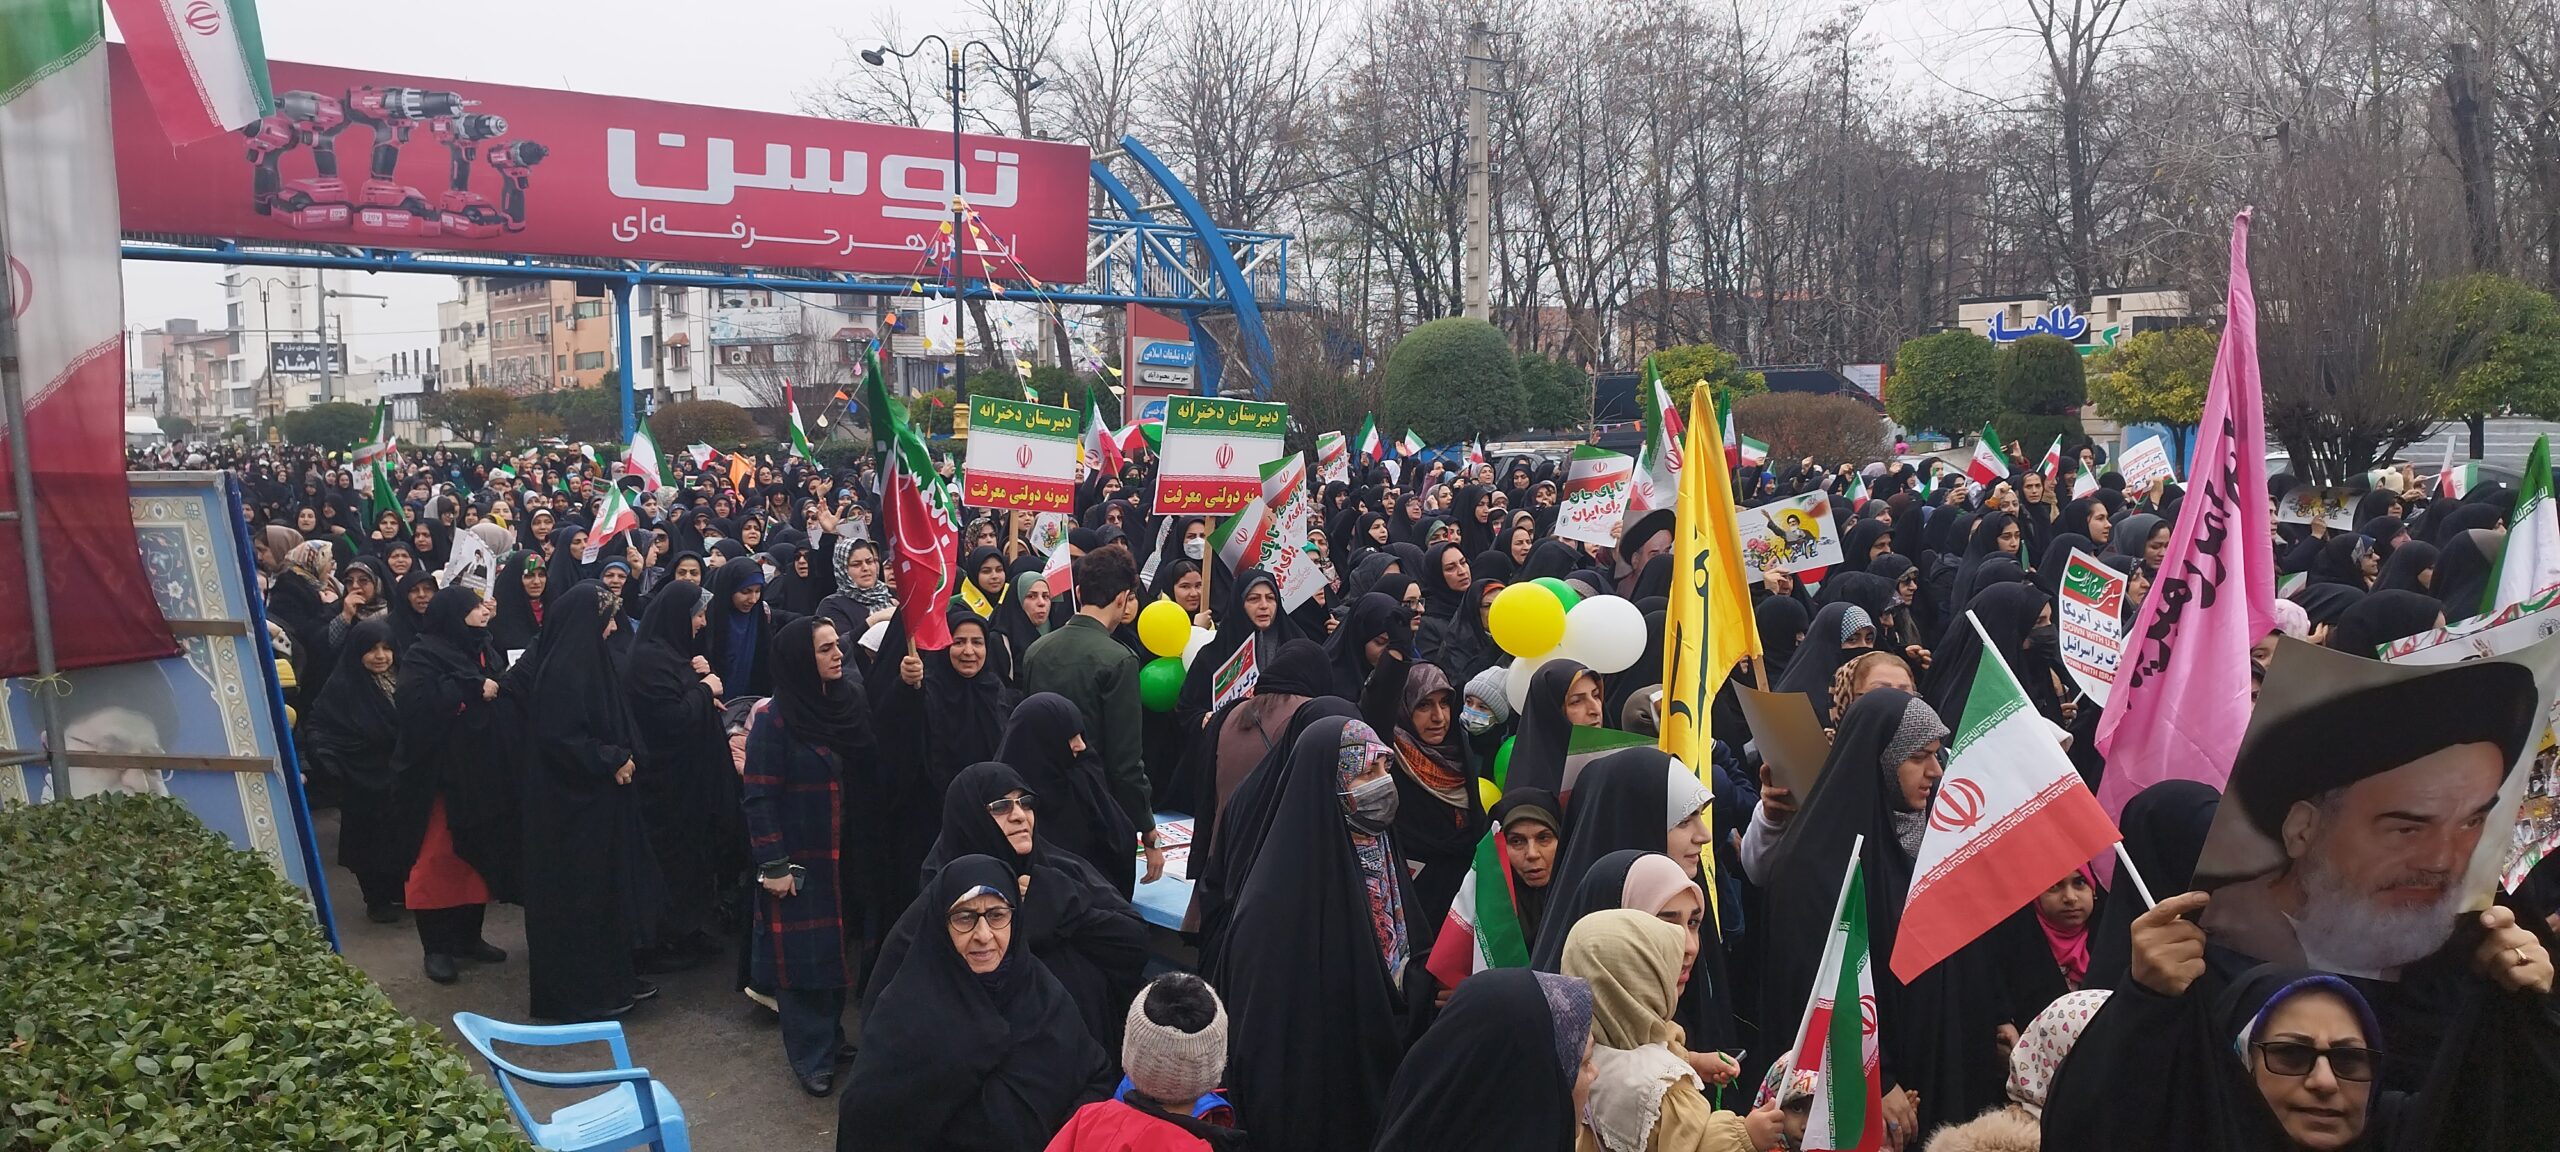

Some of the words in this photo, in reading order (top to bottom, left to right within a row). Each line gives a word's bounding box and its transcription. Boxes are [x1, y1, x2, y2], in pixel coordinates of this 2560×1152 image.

[607, 127, 1019, 223] توسن
[979, 401, 1022, 424] دخترانه
[1025, 408, 1072, 432] دبیرستان
[1177, 400, 1225, 424] دخترانه
[1227, 403, 1279, 428] دبیرستان
[970, 480, 1007, 502] معرفت
[1009, 485, 1041, 507] دولتی
[1044, 487, 1070, 509] نمونه
[1163, 484, 1202, 509] معرفت
[1204, 486, 1240, 509] دولتی
[1569, 488, 1593, 505] جان
[1614, 481, 1626, 492] تا
[1571, 504, 1600, 522] ایران
[1599, 500, 1621, 515] برای
[1266, 524, 1280, 539] تا
[1279, 545, 1299, 569] برای
[2062, 599, 2091, 624] آمریکا
[2063, 621, 2086, 637] DOWN
[2086, 629, 2104, 644] WITH
[2102, 620, 2121, 639] مرگ
[2063, 635, 2094, 658] اسرائیل
